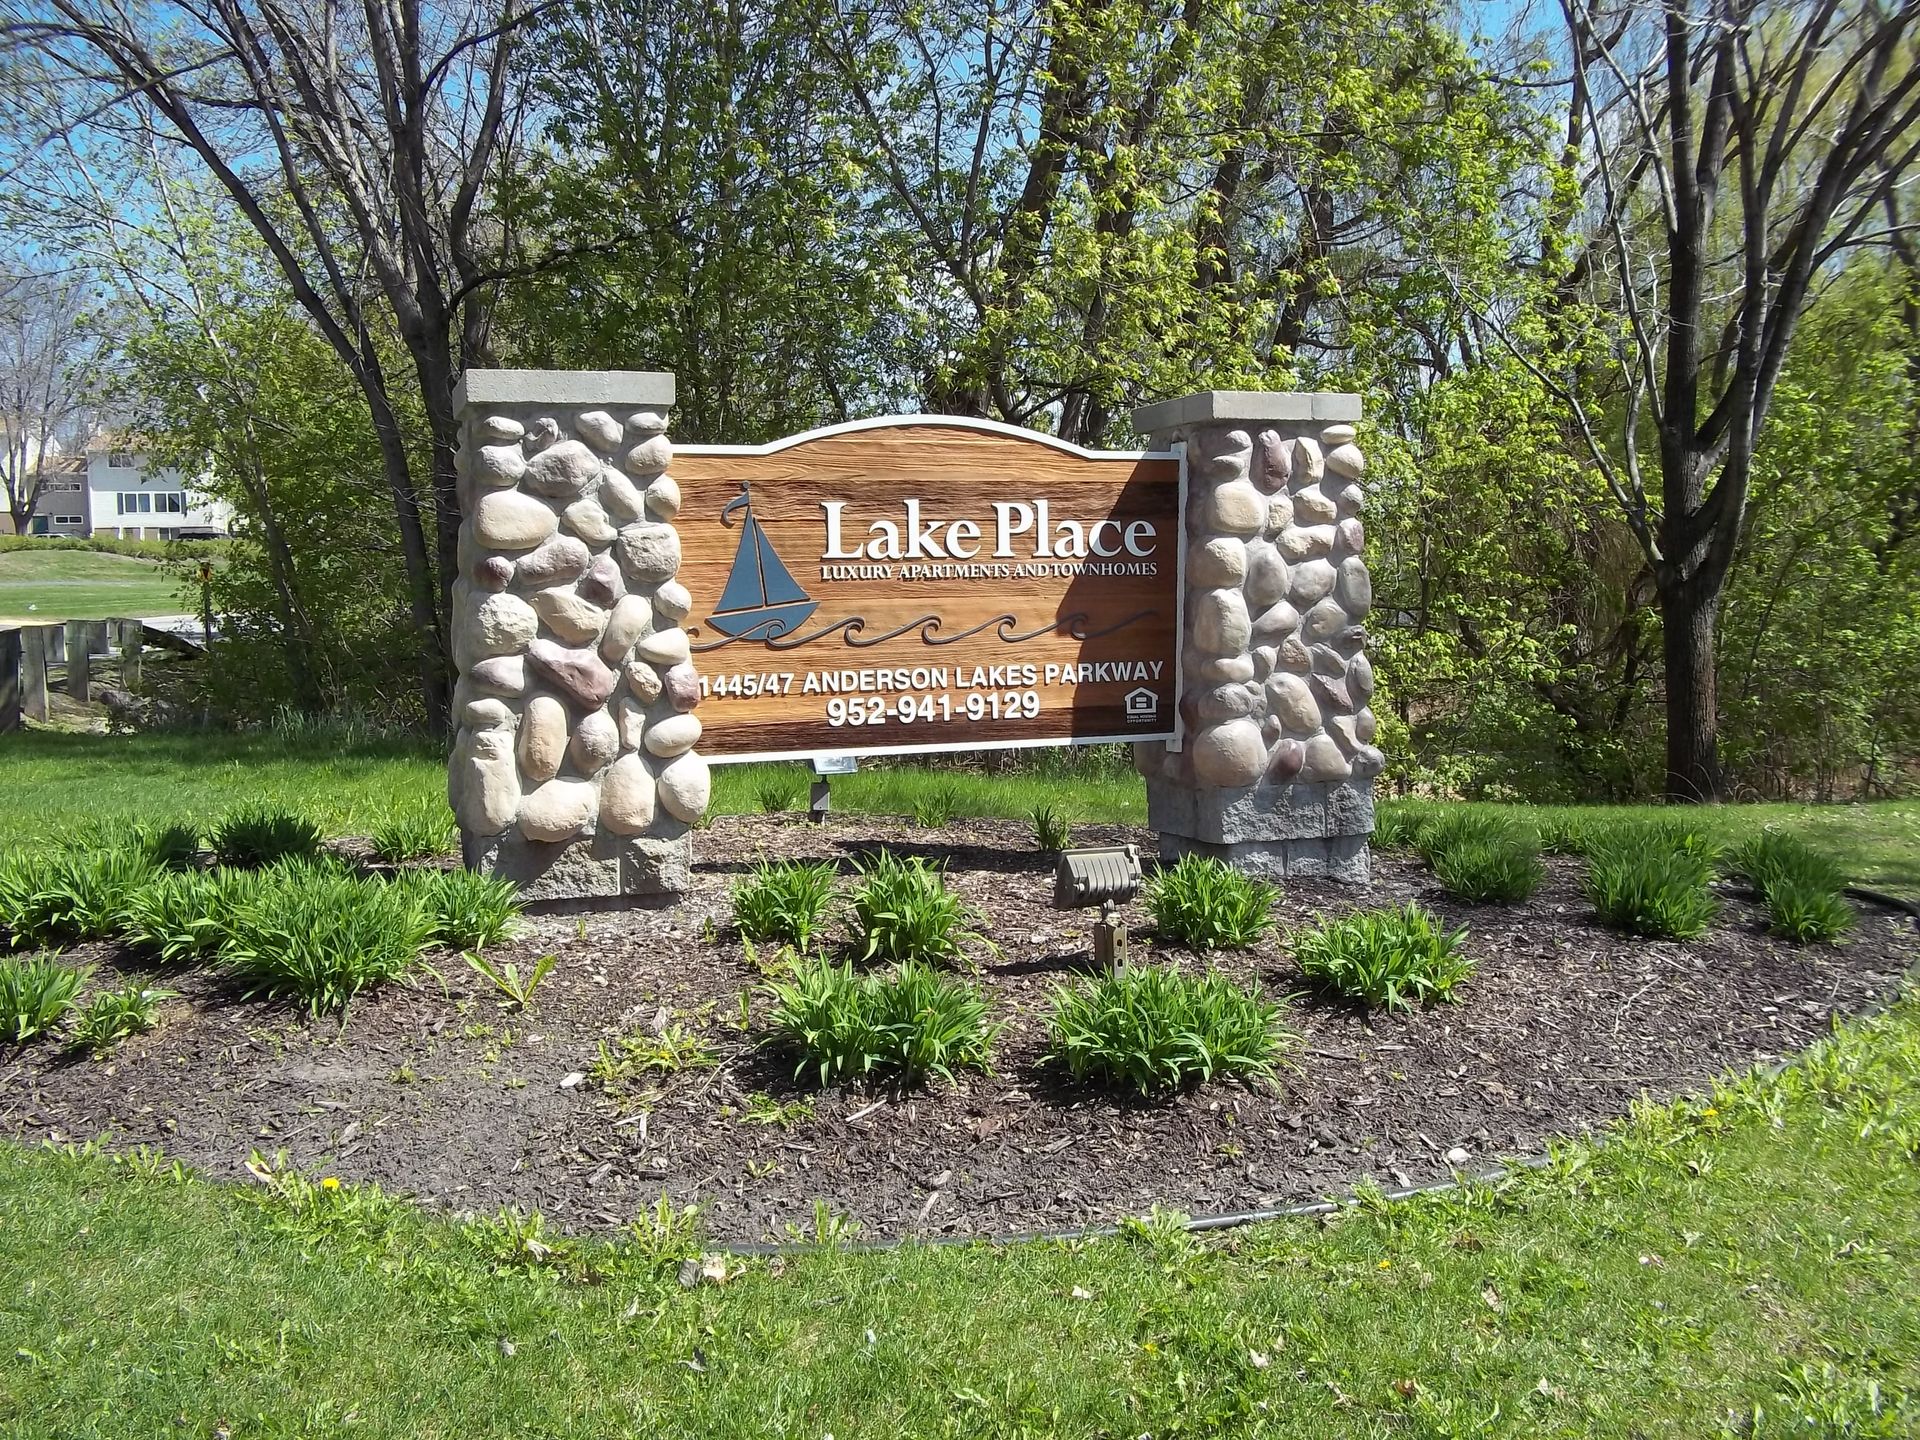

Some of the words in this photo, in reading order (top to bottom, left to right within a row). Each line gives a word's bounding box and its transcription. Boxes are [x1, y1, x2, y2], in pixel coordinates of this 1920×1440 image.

[820, 499, 982, 560] Lake
[991, 499, 1157, 558] Place
[821, 564, 893, 580] LUXURY
[899, 563, 1010, 579] APARTMENTS
[1013, 563, 1049, 577] AND
[1050, 562, 1158, 577] TOWNHOMES
[699, 672, 795, 697] 1445/47
[802, 667, 948, 693] ANDERSON
[956, 664, 1038, 687] LAKES
[1044, 660, 1164, 684] PARKWAY
[826, 690, 1041, 728] 952-941-9129
